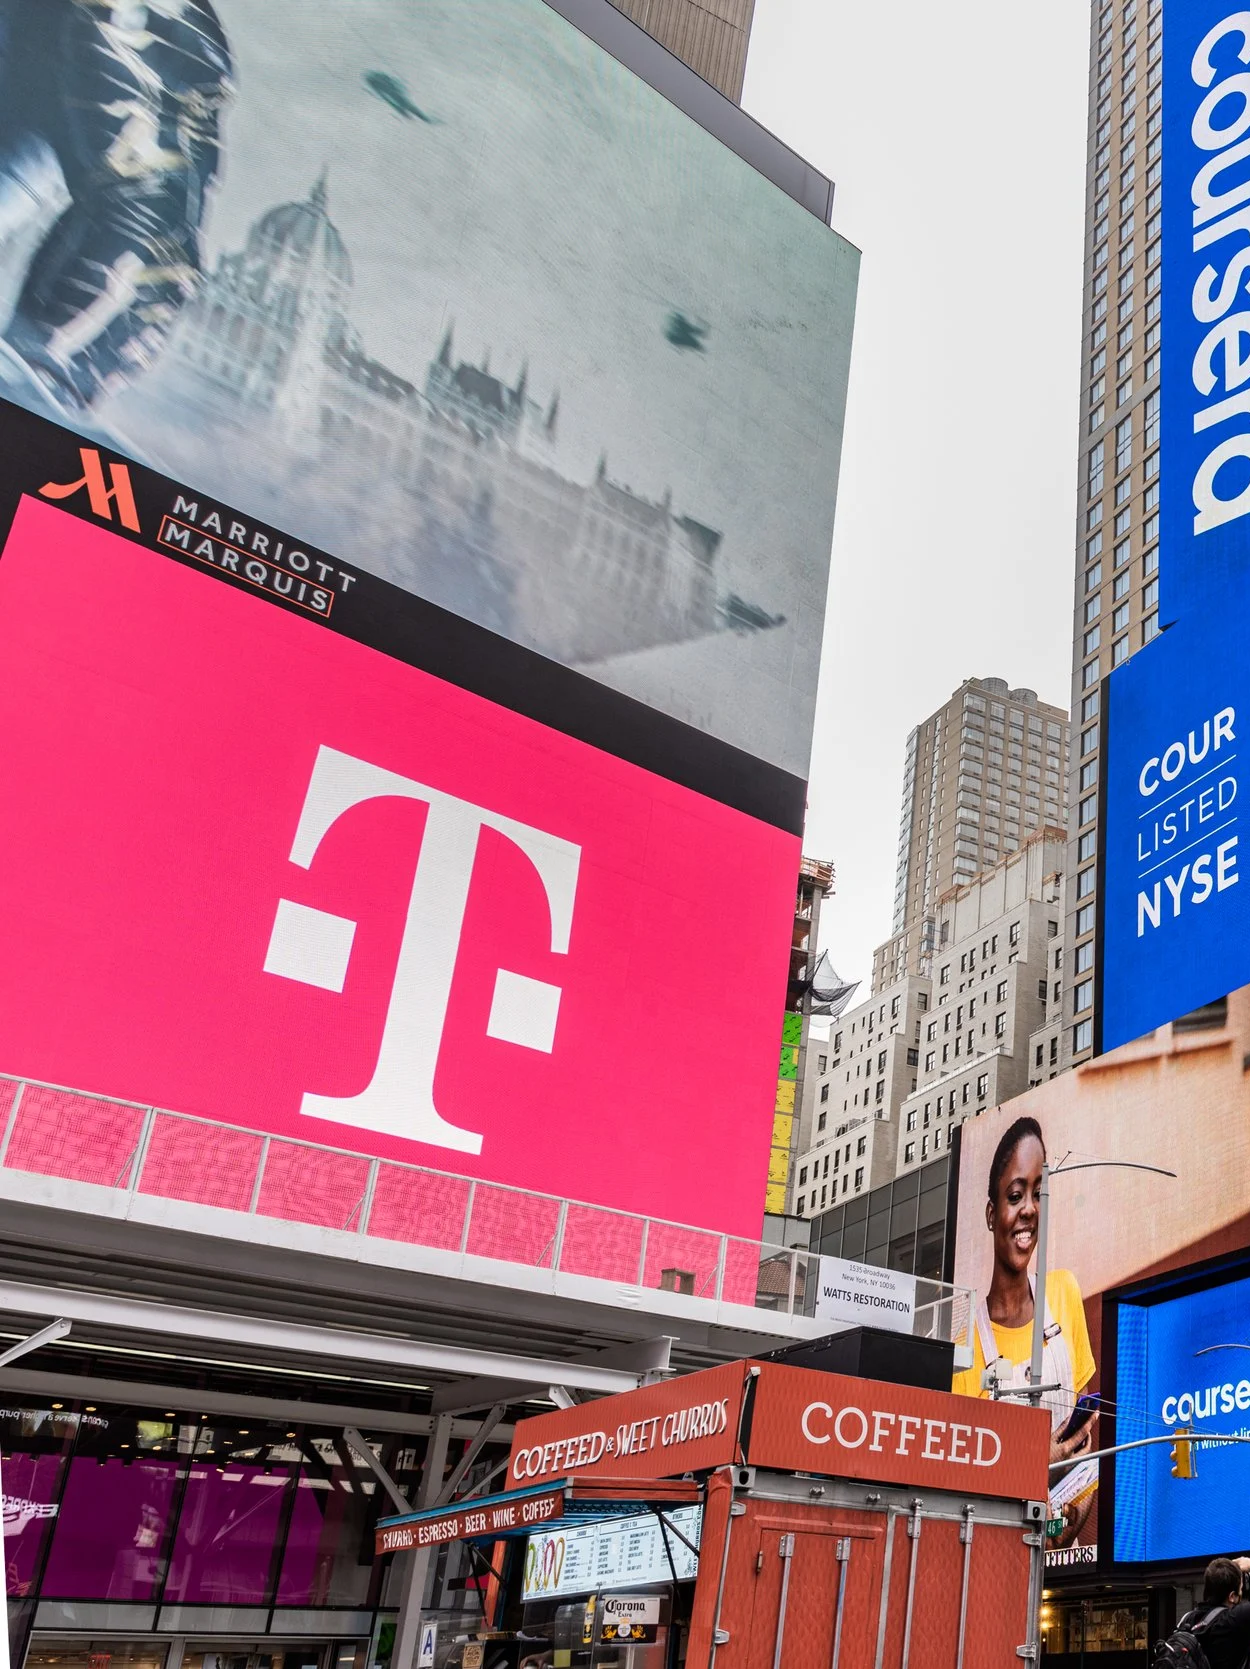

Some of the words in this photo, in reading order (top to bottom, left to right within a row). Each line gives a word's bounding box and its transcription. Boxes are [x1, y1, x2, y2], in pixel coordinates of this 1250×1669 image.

[164, 522, 328, 611] MARQUIS
[172, 495, 357, 593] MARRIOTT
[1138, 706, 1236, 797] COUR
[1138, 776, 1237, 861] LISTED
[1137, 835, 1239, 938] NYSE
[842, 1273, 855, 1282] New
[856, 1275, 869, 1287] York,
[870, 1279, 878, 1287] NY
[849, 1265, 862, 1273] 1535
[823, 1286, 851, 1302] WATTS
[853, 1293, 910, 1313] RESTORATION
[513, 1431, 607, 1480] COFFEED
[605, 1437, 614, 1453] &
[613, 1416, 661, 1458] SWEET
[661, 1398, 729, 1447] CHURROS
[801, 1401, 1002, 1466] COFFEED
[418, 1519, 458, 1544] ESPRESSO
[465, 1512, 487, 1533] BEER
[492, 1507, 516, 1528] WINE
[522, 1497, 555, 1521] COFFEE
[1048, 1521, 1056, 1534] 46
[605, 1599, 645, 1613] Corona
[423, 1629, 433, 1655] A
